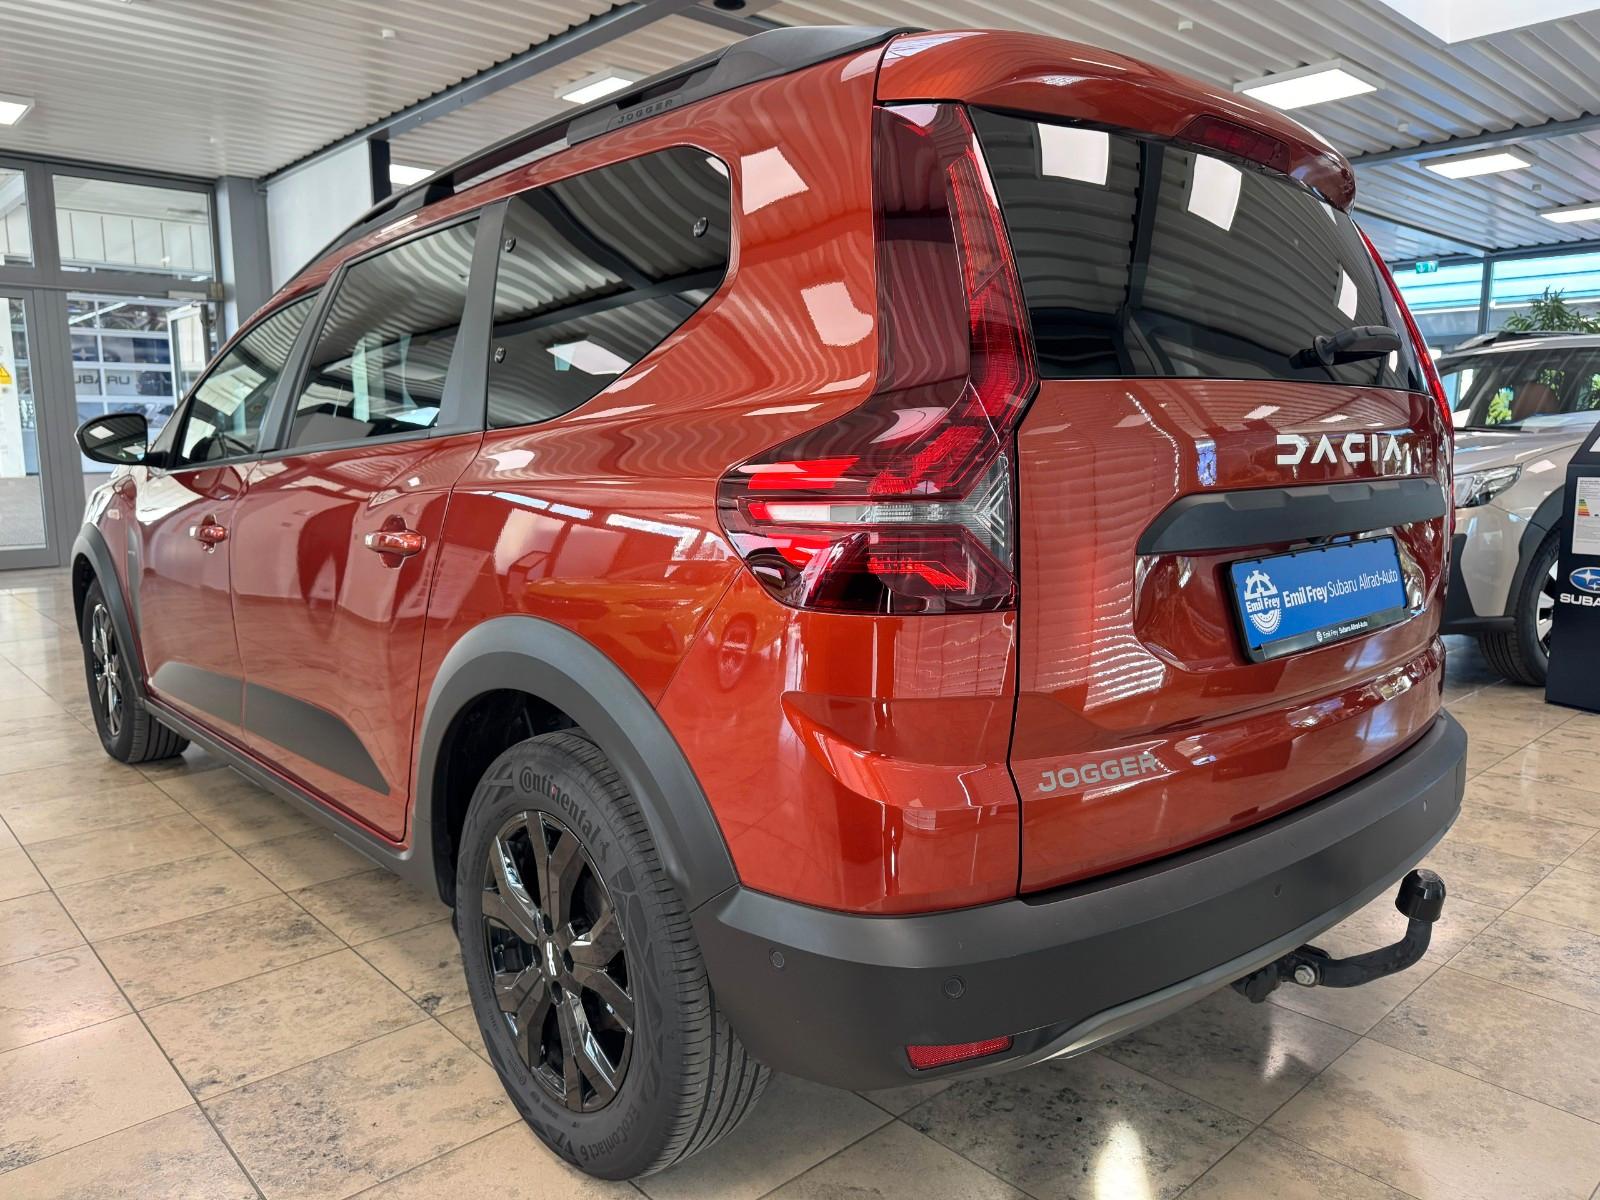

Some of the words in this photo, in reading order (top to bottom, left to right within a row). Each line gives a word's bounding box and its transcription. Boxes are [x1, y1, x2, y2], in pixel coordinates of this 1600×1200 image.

[617, 99, 673, 123] JOGGER
[75, 374, 130, 385] UBRU
[1276, 433, 1401, 465] DACIA
[1246, 598, 1263, 613] Emil
[1264, 596, 1280, 610] Frey
[1283, 587, 1306, 608] Emil
[1306, 584, 1328, 604] Frey
[1328, 578, 1357, 598] Subaru
[1359, 569, 1398, 590] Allrad-Auto
[1039, 752, 1158, 792] JOGGER
[520, 766, 600, 845] Continental
